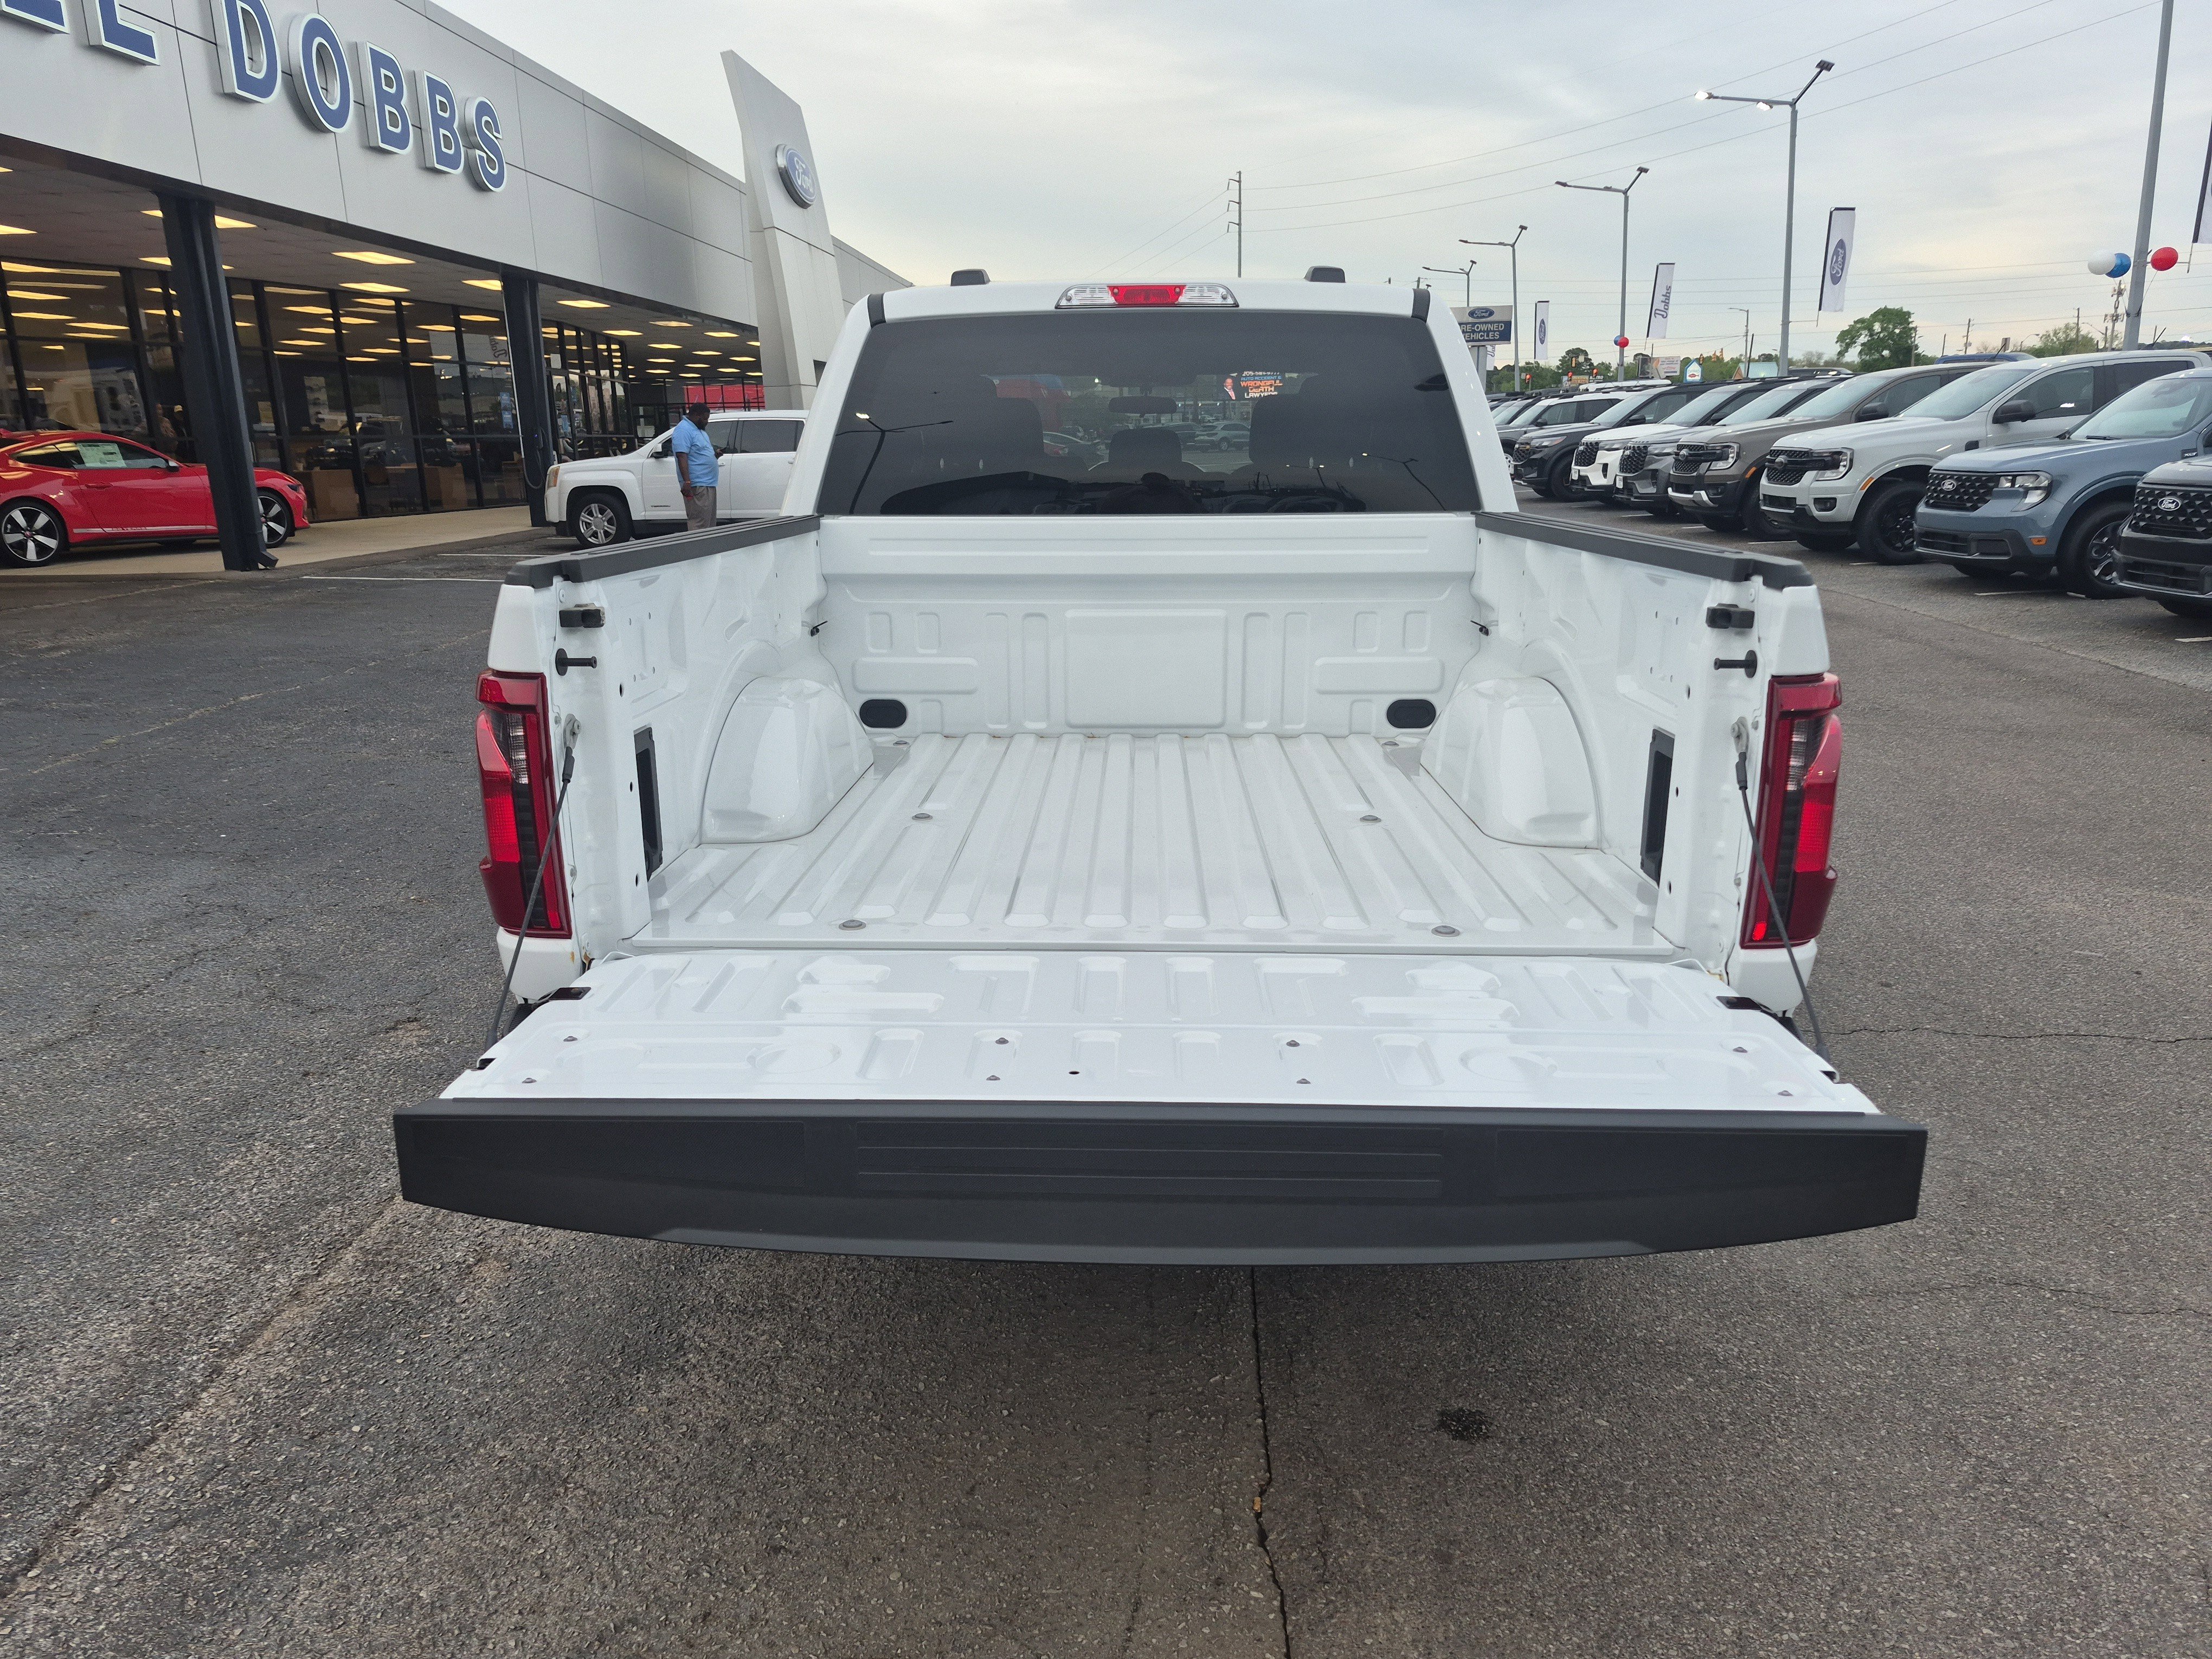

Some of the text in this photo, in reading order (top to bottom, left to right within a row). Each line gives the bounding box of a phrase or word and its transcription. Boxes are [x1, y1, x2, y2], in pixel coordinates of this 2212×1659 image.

[214, 0, 507, 192] DOBBS
[1654, 285, 1671, 319] Dobbs
[1461, 323, 1504, 332] RE-OWNED
